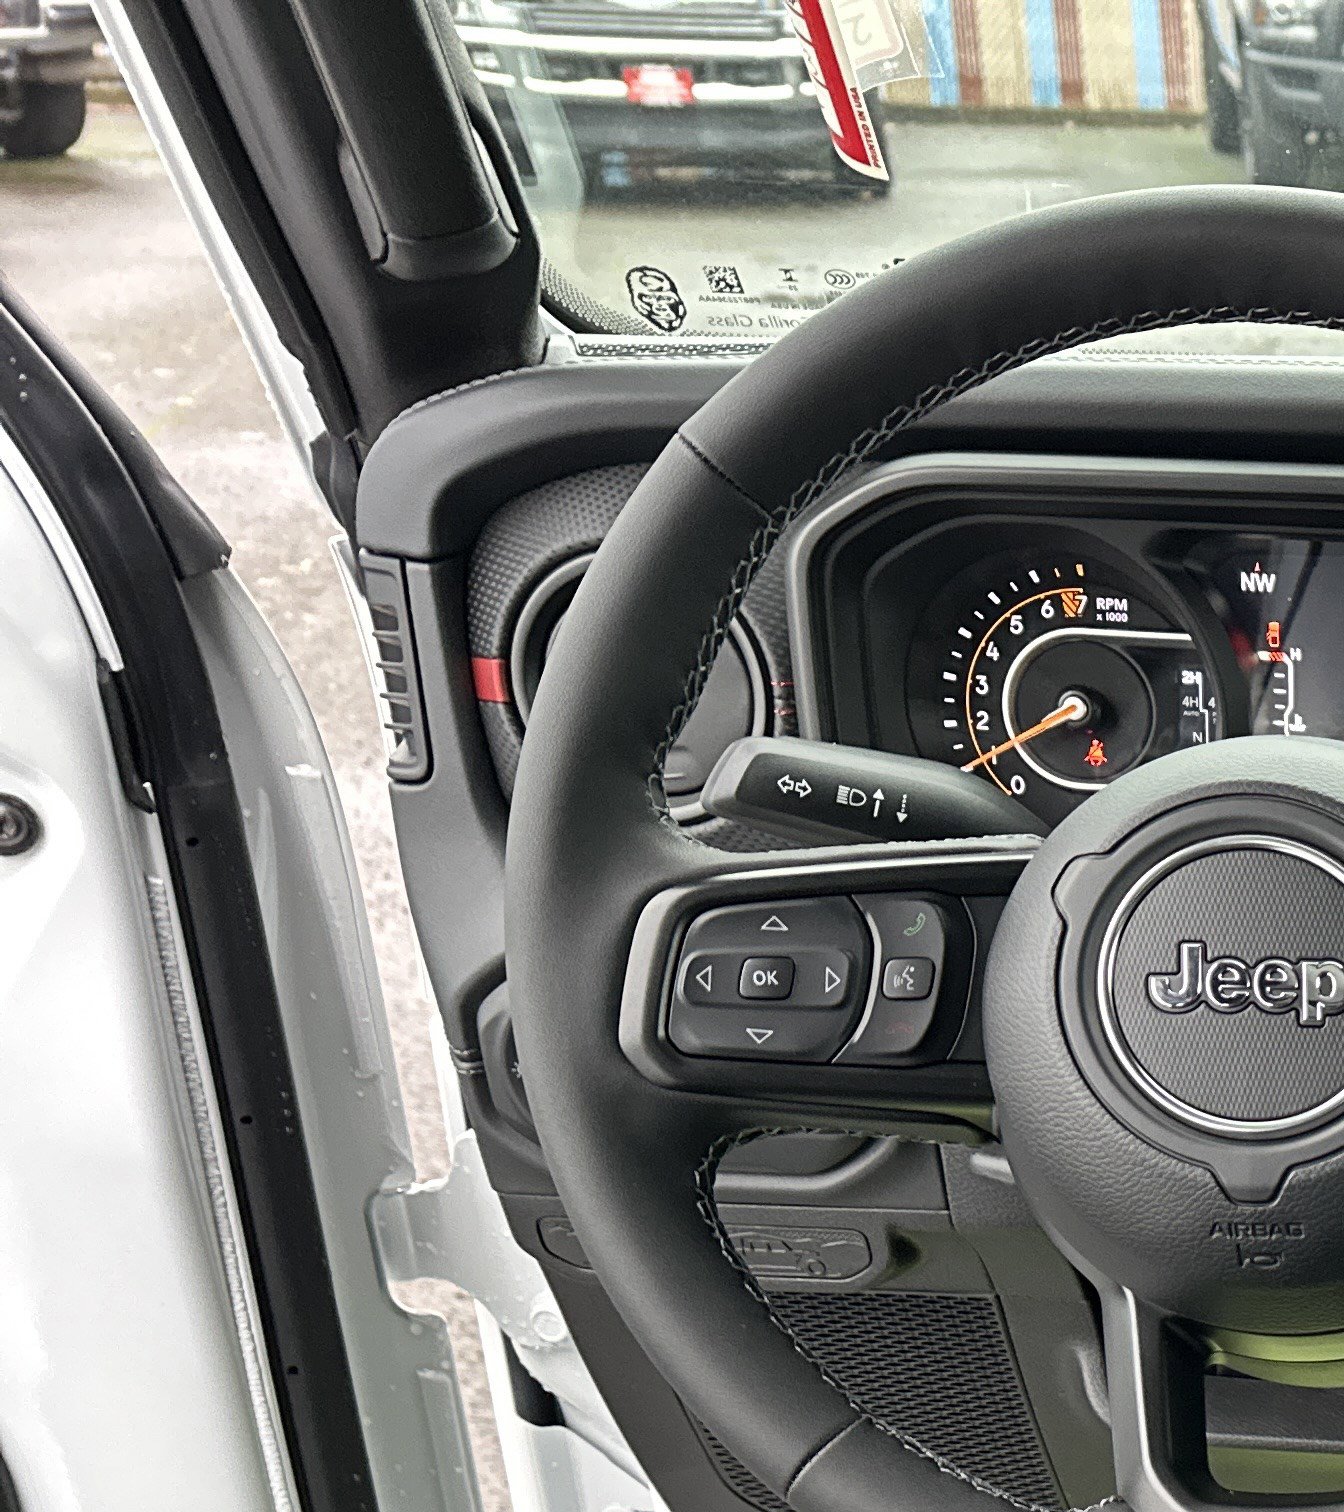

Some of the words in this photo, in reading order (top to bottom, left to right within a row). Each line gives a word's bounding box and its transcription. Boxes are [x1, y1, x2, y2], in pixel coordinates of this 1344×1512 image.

[1240, 571, 1276, 593] NW
[1041, 599, 1055, 619] 6
[1074, 594, 1087, 615] 7
[1096, 597, 1129, 612] RPM
[1009, 614, 1024, 634] 5
[1105, 612, 1129, 623] 1000
[985, 641, 1000, 661] 4
[1290, 648, 1302, 661] H
[975, 674, 988, 695] 3
[1182, 696, 1199, 708] 4H
[976, 711, 989, 731] 2
[1192, 731, 1203, 743] N
[1010, 775, 1025, 795] 0
[752, 970, 779, 987] OK
[1209, 1220, 1306, 1240] AIRBAG
